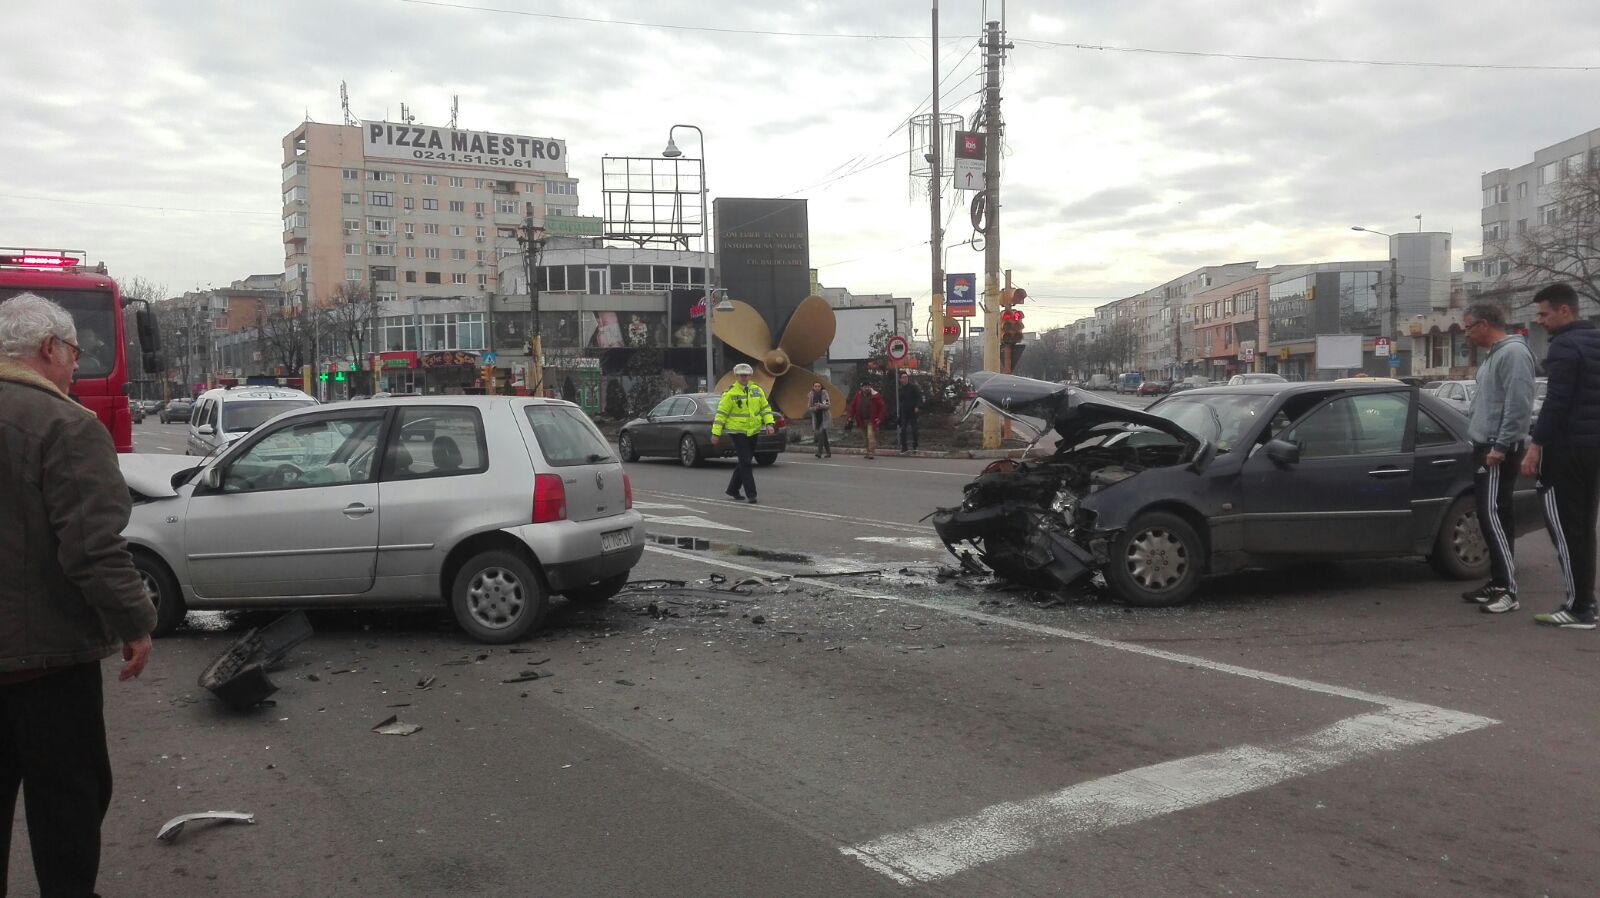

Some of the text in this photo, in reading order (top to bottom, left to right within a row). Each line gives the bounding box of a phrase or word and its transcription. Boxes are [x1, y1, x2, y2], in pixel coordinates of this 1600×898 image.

[370, 123, 560, 161] PIZZA MAESTRO
[413, 149, 532, 169] 0241.51.51.61
